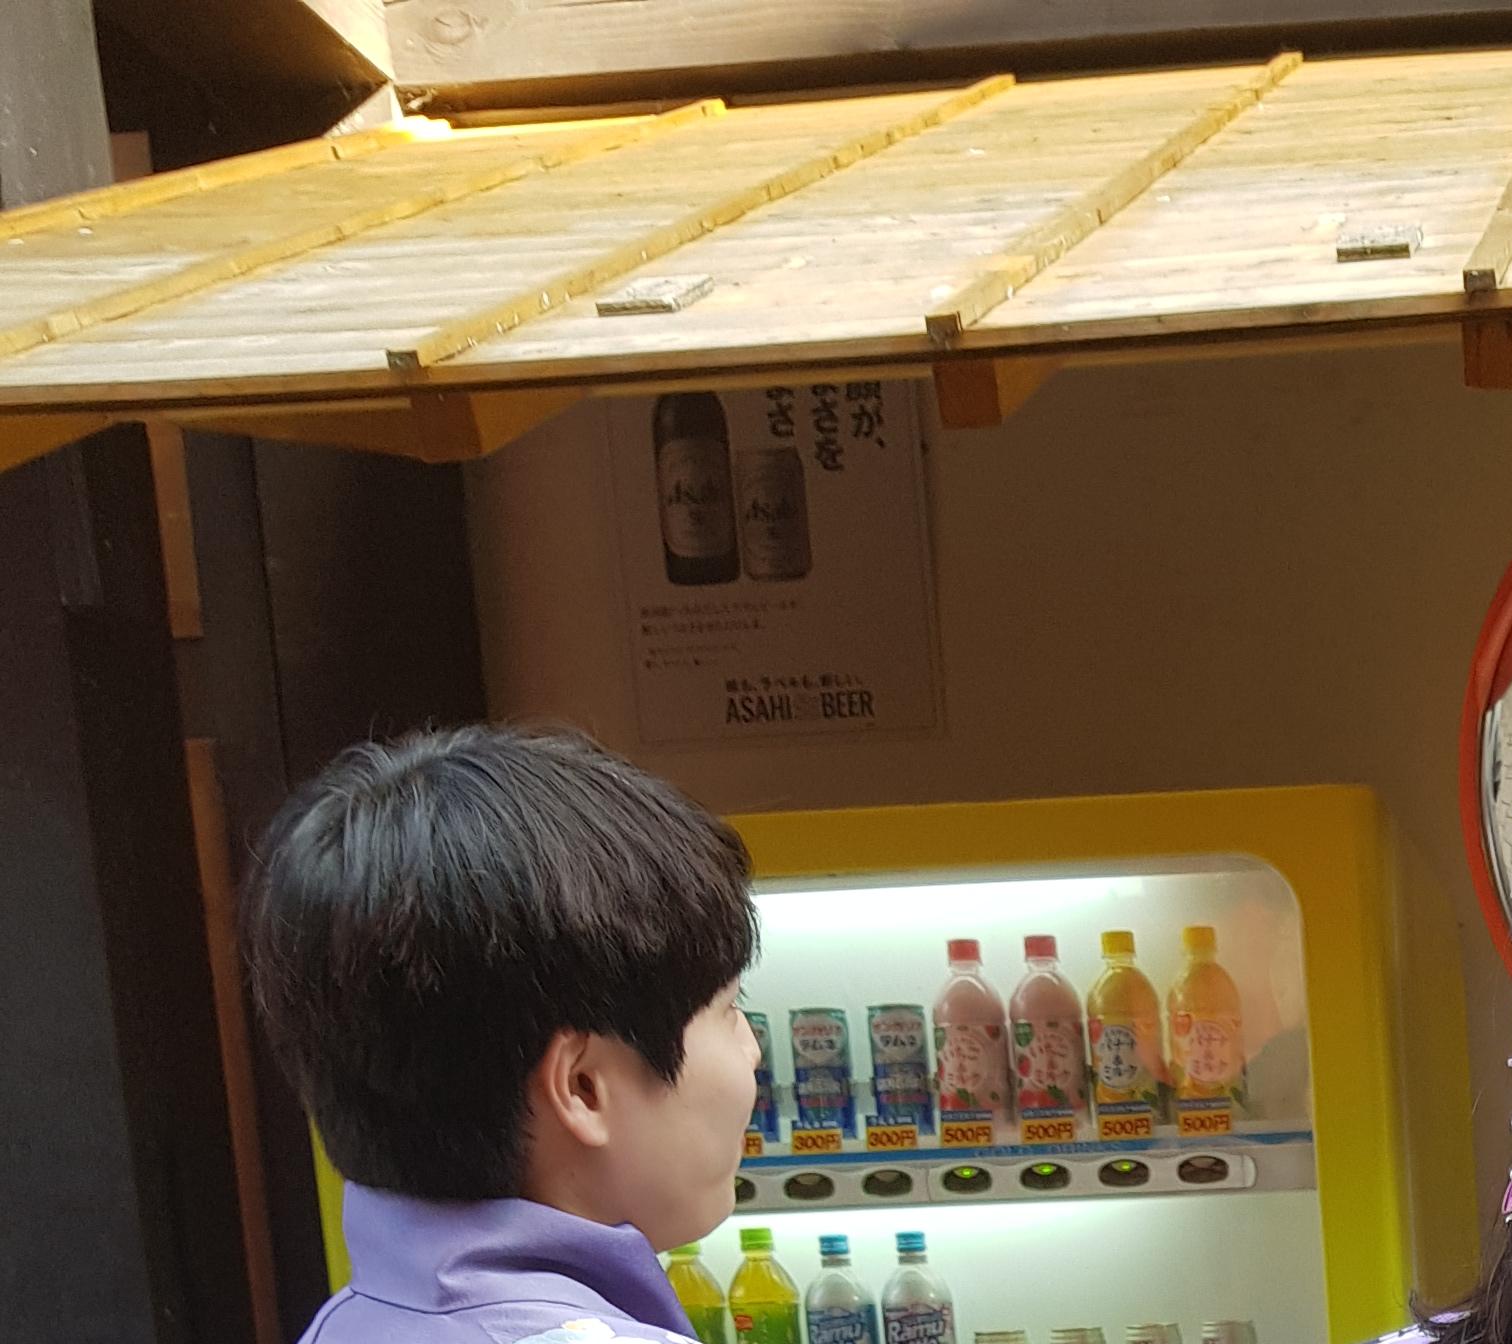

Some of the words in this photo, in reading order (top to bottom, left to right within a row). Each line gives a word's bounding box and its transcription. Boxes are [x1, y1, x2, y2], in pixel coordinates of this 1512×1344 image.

[726, 695, 792, 724] ASAHI
[820, 690, 875, 719] BEER
[1026, 1122, 1073, 1140] 500円
[1102, 1117, 1150, 1137] 500円
[1182, 1114, 1230, 1132] 500円
[793, 1134, 838, 1151] 300円
[869, 1130, 915, 1147] 300円
[944, 1126, 991, 1144] 500円
[889, 1319, 944, 1344] Ramu
